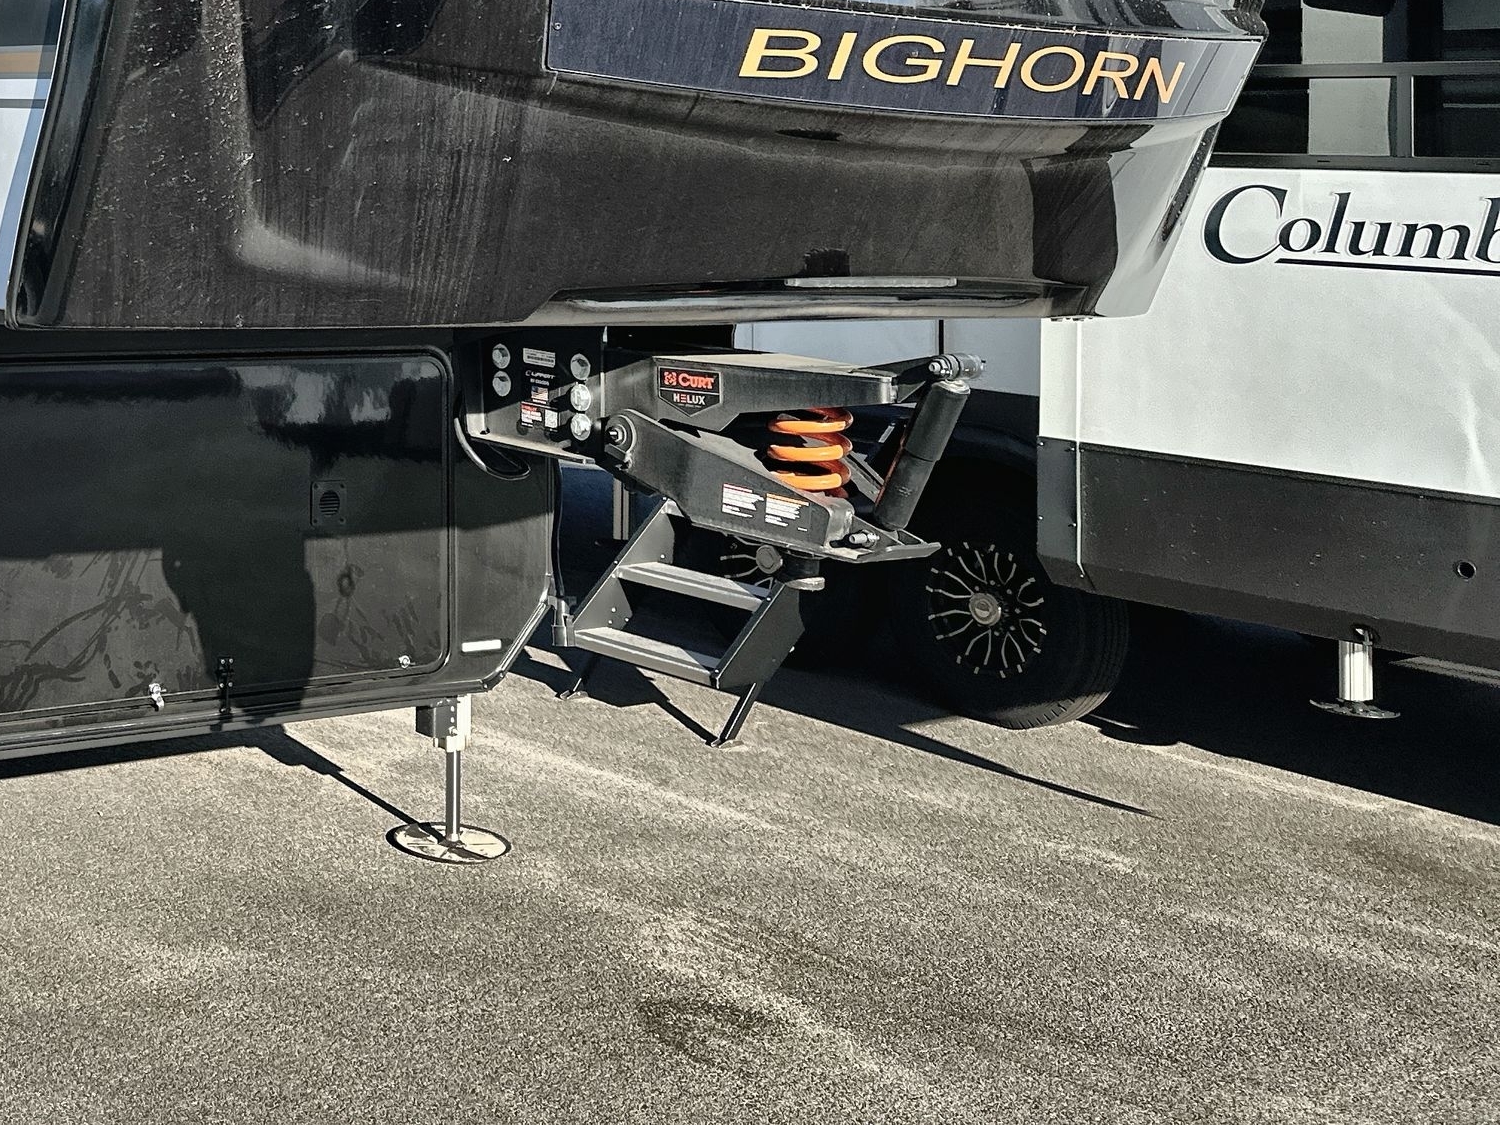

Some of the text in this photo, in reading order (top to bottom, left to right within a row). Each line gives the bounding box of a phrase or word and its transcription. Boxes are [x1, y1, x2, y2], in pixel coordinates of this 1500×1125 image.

[738, 27, 1186, 104] BIGHORN
[678, 373, 714, 389] CURT
[673, 393, 706, 405] HELUX
